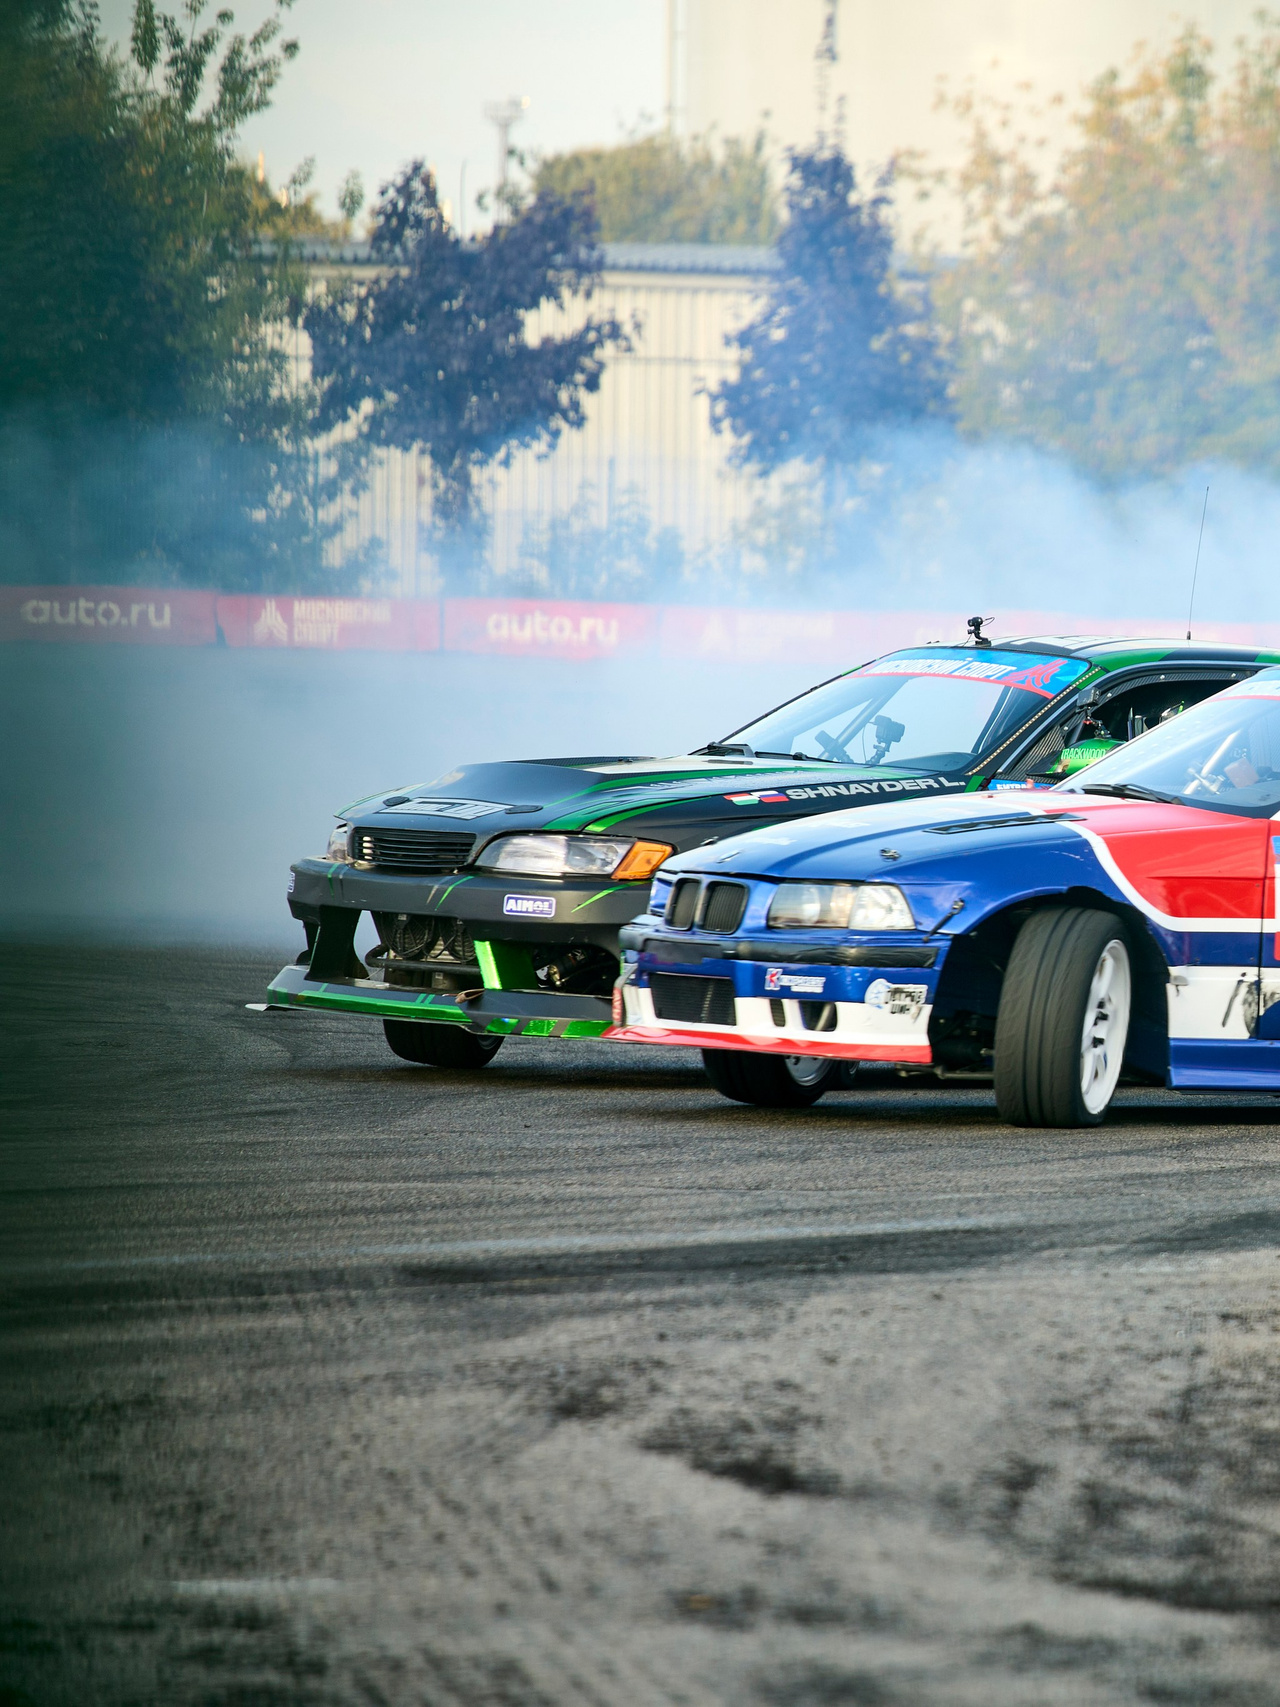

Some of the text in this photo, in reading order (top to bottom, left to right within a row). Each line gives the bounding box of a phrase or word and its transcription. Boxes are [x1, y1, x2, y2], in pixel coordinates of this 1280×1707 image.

[24, 597, 172, 629] auto.ru
[486, 608, 620, 647] auto.ru
[788, 775, 966, 800] SHNAYDER L.
